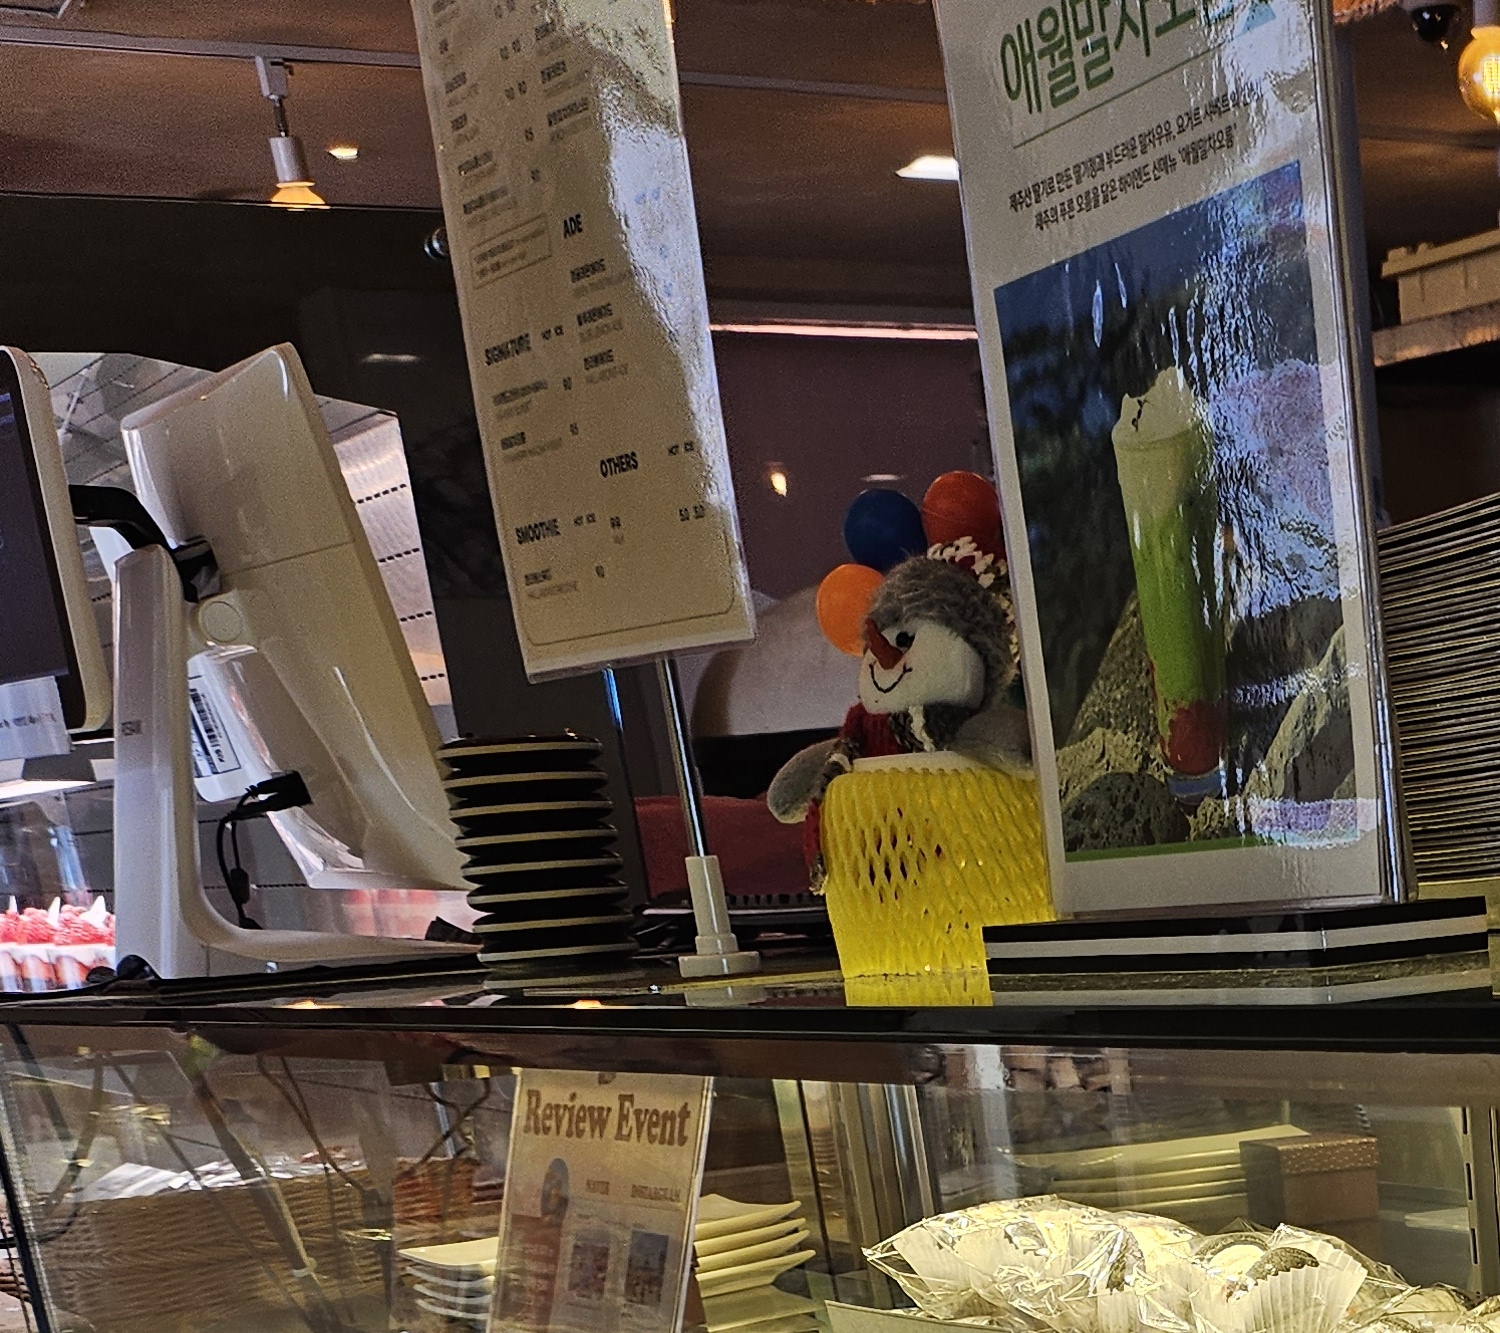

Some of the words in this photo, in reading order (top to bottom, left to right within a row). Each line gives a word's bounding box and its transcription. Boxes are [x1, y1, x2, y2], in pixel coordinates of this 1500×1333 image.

[1001, 0, 1233, 114] 애월말차
[563, 213, 583, 239] ADE
[485, 333, 532, 366] SIGNATURE
[600, 451, 639, 478] OTHERS
[515, 518, 561, 545] SMOOTHIE
[523, 1089, 613, 1140] Review
[614, 1093, 691, 1147] Event
